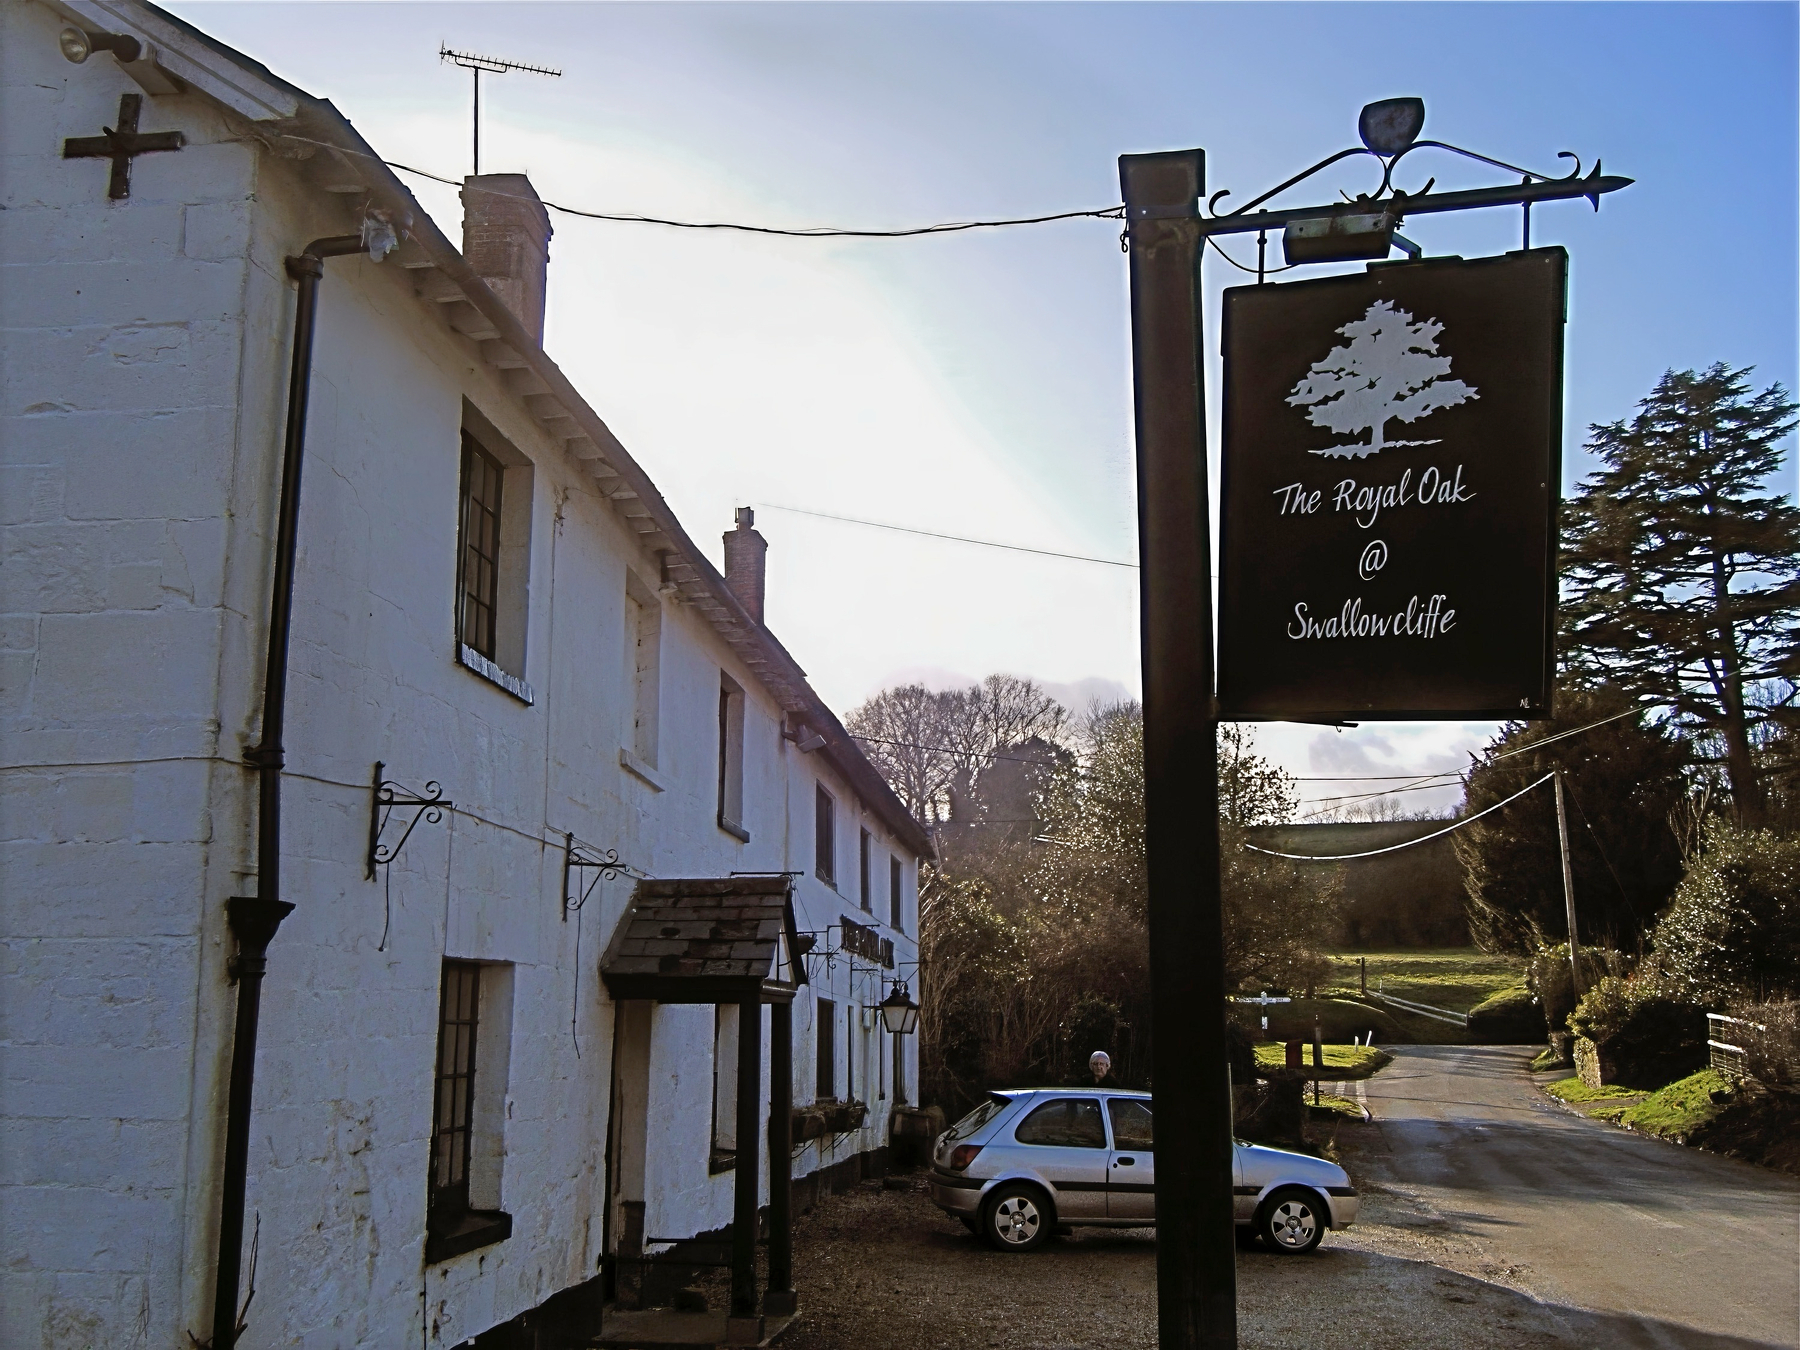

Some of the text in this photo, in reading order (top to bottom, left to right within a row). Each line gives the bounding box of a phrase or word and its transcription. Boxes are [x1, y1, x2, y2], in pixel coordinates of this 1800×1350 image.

[1273, 465, 1476, 528] The Royal Oak
[1359, 539, 1388, 580] @
[1288, 595, 1456, 639] Swallowcliffe
